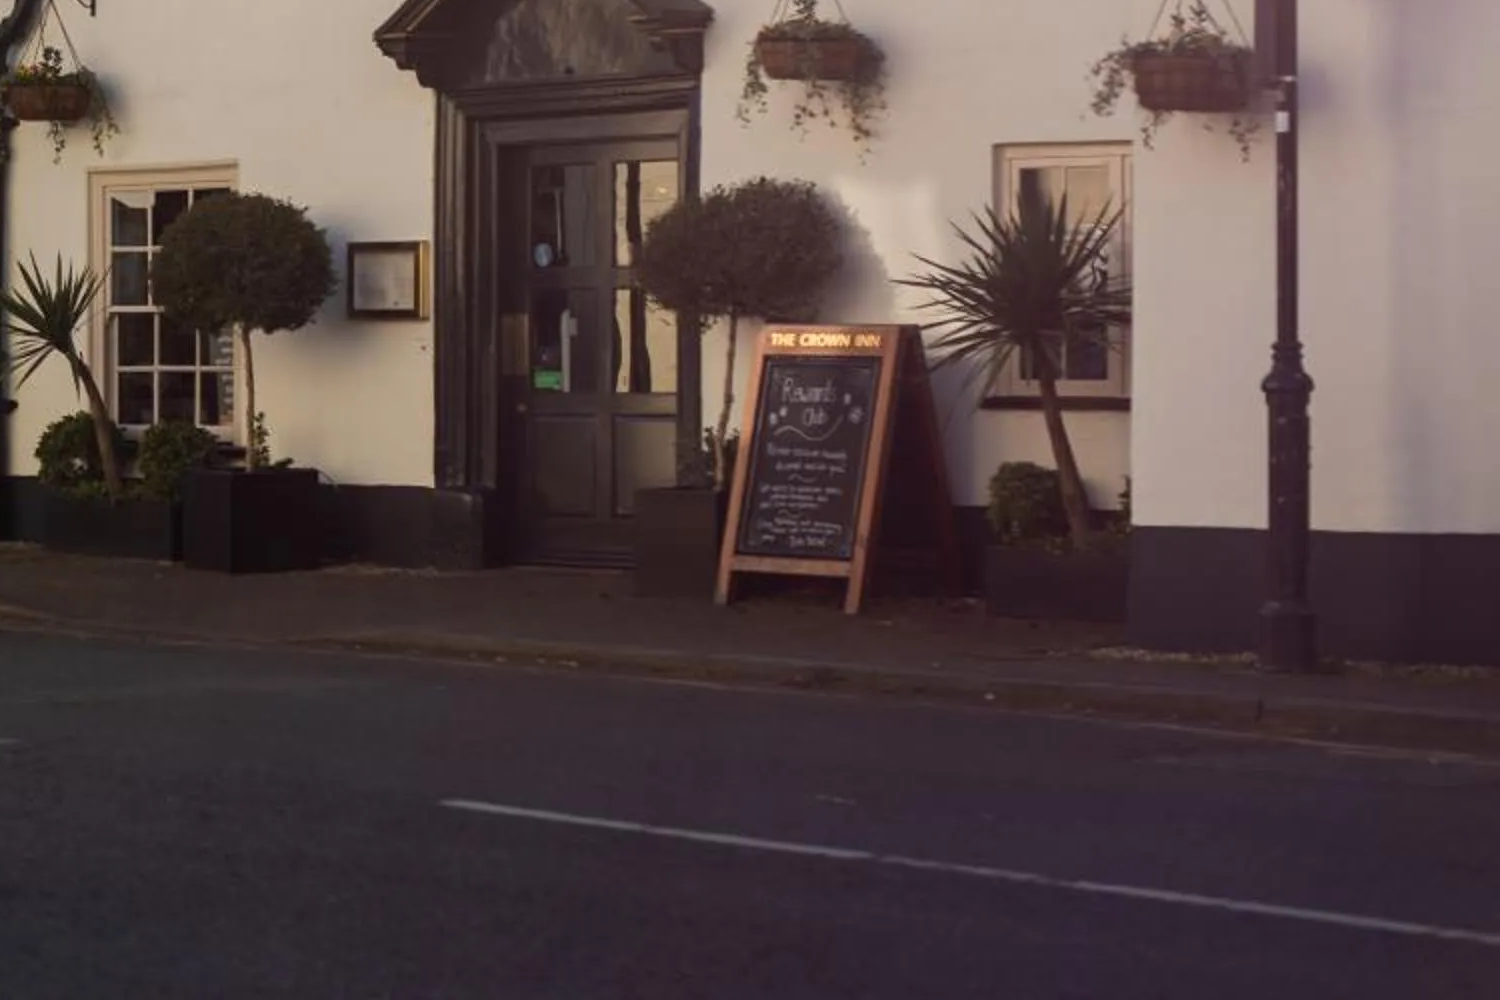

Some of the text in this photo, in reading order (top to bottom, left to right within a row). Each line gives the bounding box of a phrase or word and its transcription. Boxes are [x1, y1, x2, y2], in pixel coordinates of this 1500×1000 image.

[771, 332, 882, 349] THE CROWN INN
